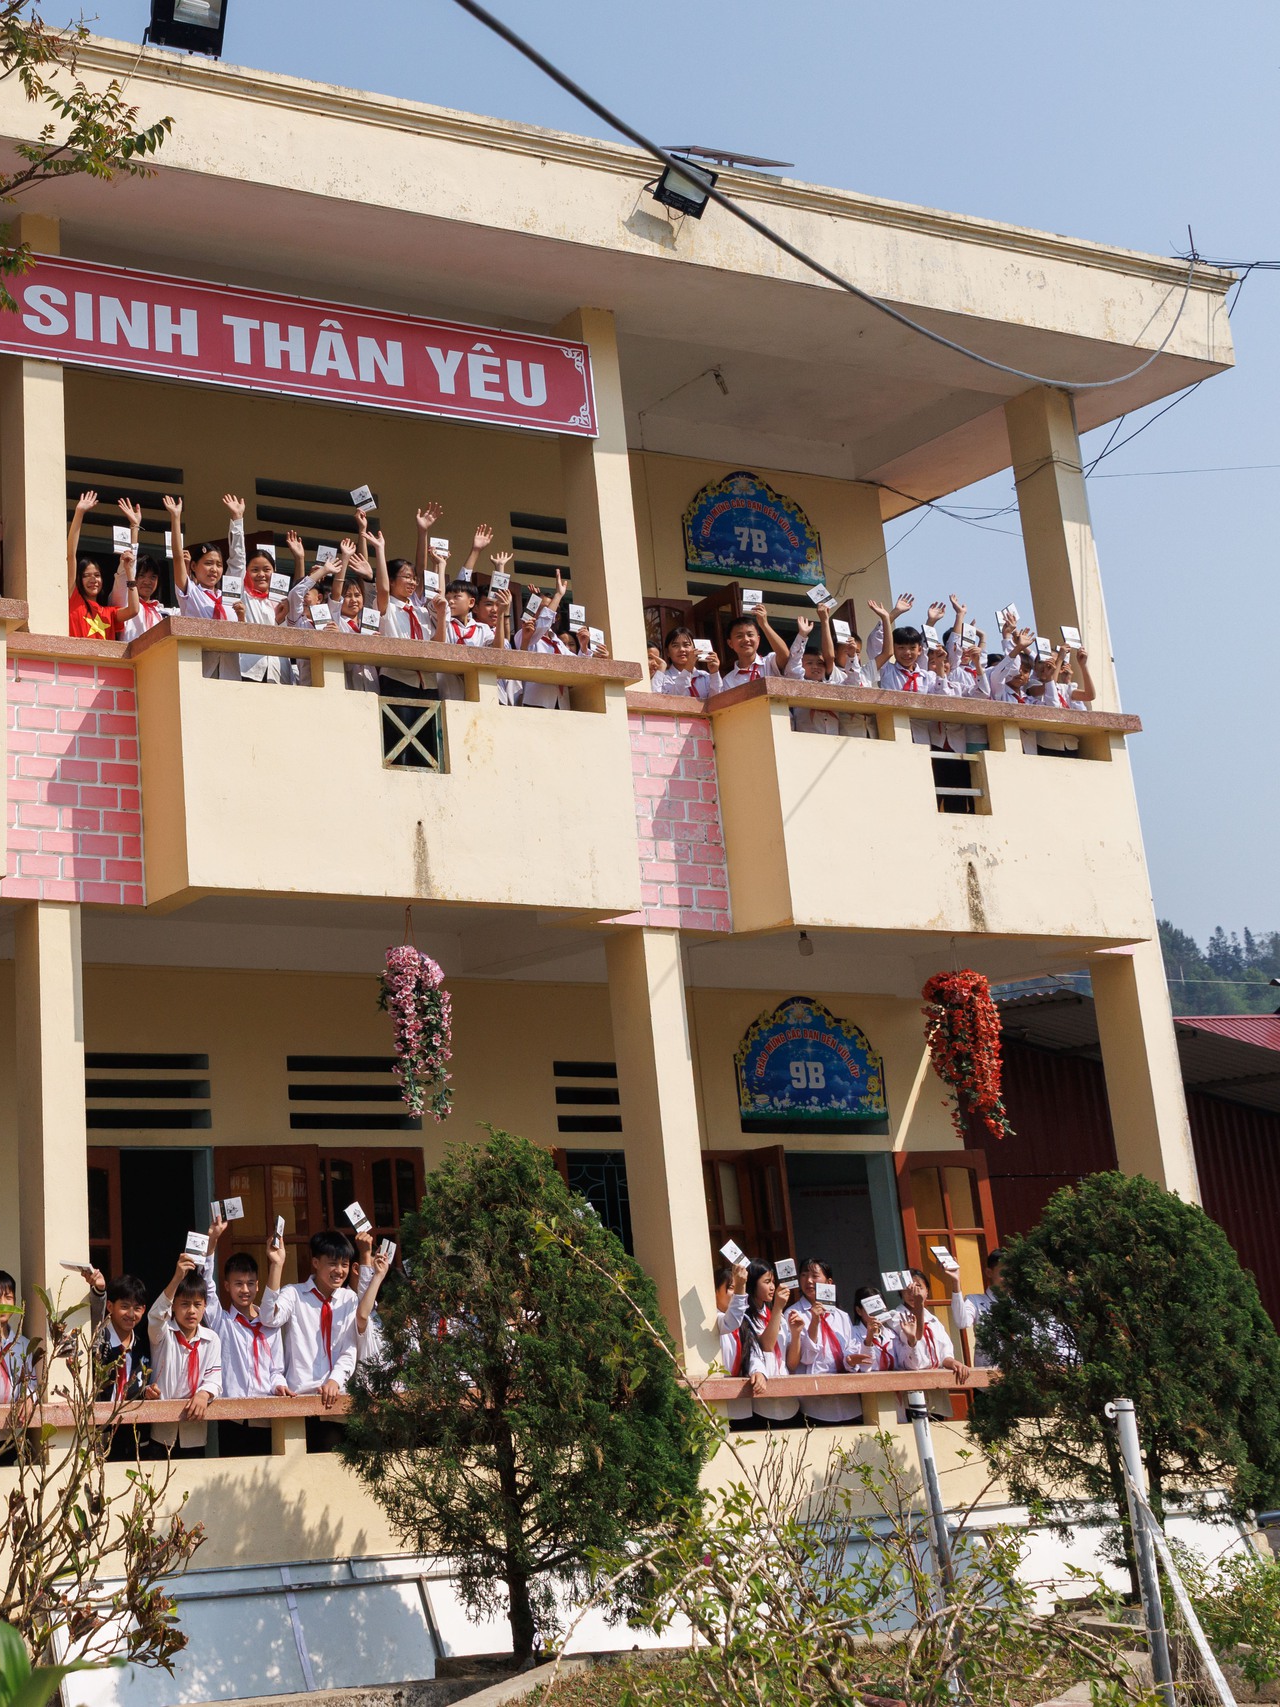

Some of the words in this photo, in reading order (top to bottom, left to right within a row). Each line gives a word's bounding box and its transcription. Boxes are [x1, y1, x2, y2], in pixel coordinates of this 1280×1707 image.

[22, 285, 198, 357] SINH
[222, 314, 405, 387] THÂN
[425, 342, 548, 407] YÊU
[734, 526, 768, 553] 7B
[755, 1051, 768, 1077] CHÀO
[785, 1027, 801, 1040] CÁC
[789, 1061, 825, 1088] 9B
